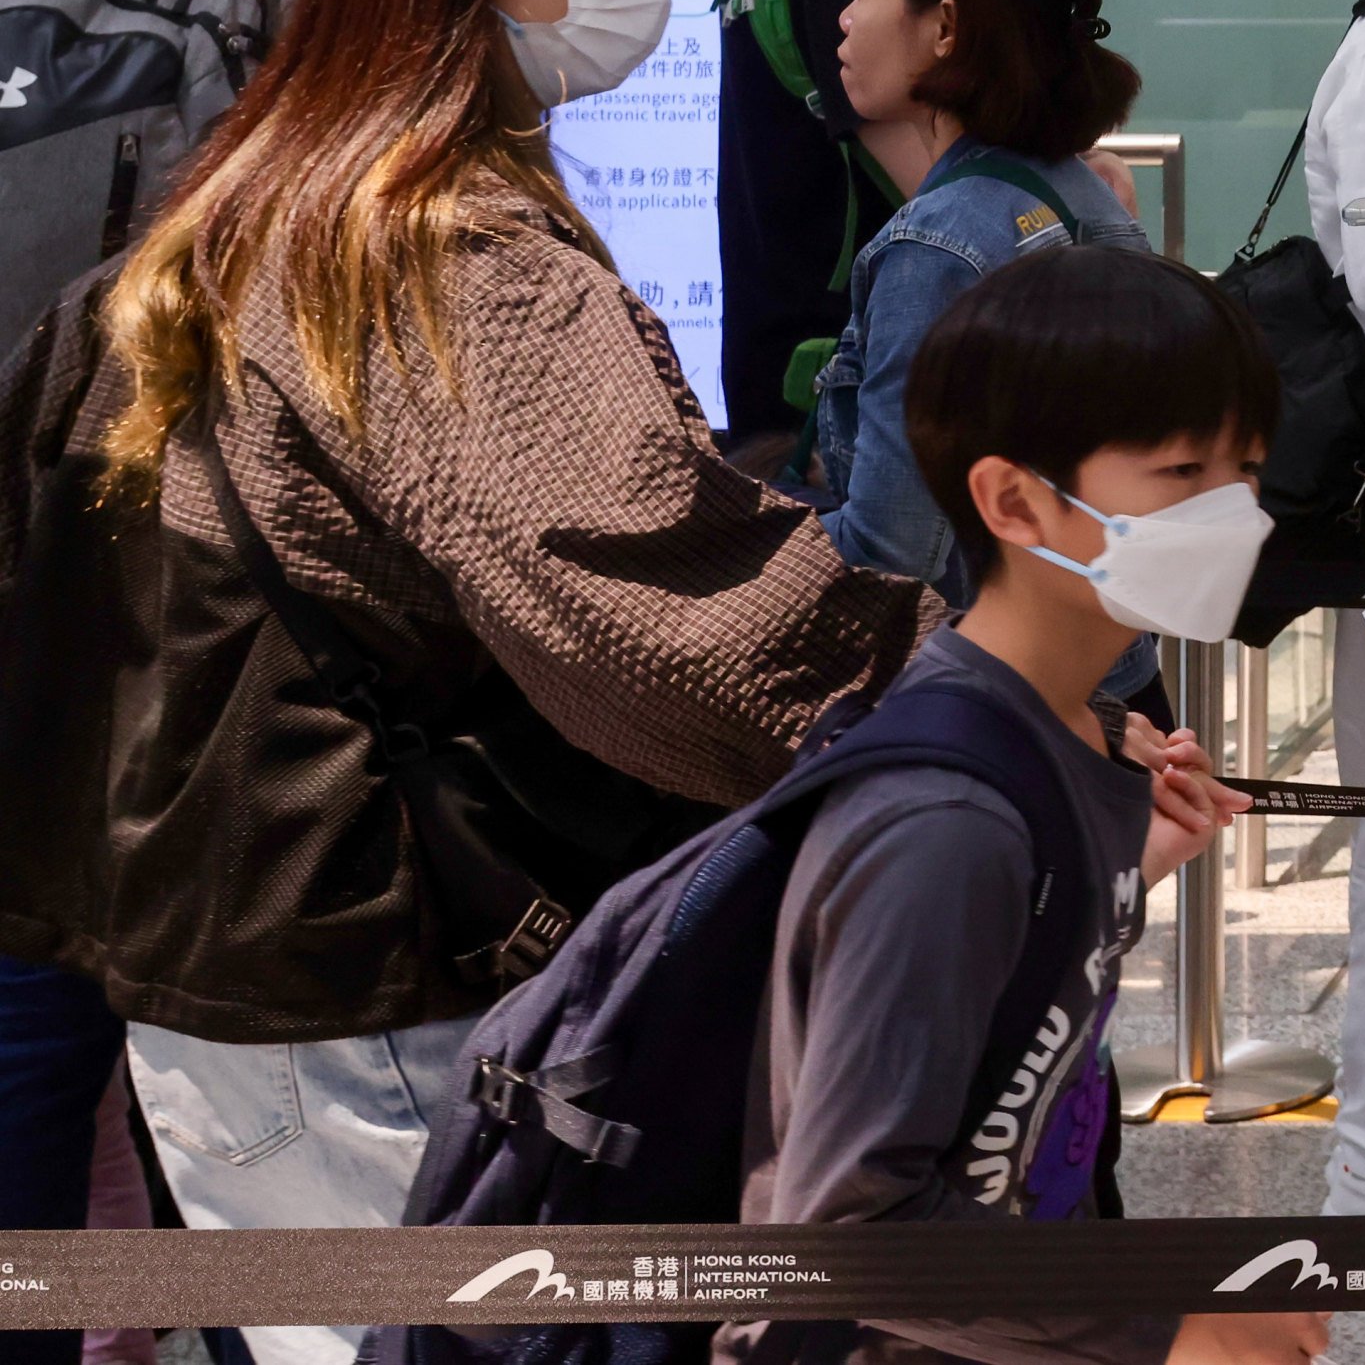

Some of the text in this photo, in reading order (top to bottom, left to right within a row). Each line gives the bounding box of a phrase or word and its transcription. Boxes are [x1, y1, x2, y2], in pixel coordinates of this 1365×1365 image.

[594, 92, 685, 107] passengers
[565, 107, 649, 122] electronic
[655, 108, 701, 122] travel
[583, 194, 612, 209] Not
[618, 193, 707, 211] applicable
[632, 1256, 680, 1278] 香港
[693, 1254, 797, 1267] HONG KONG
[693, 1271, 832, 1283] INTERNATIONAL
[583, 1280, 679, 1301] 國際機場
[693, 1288, 769, 1300] AIRPORT
